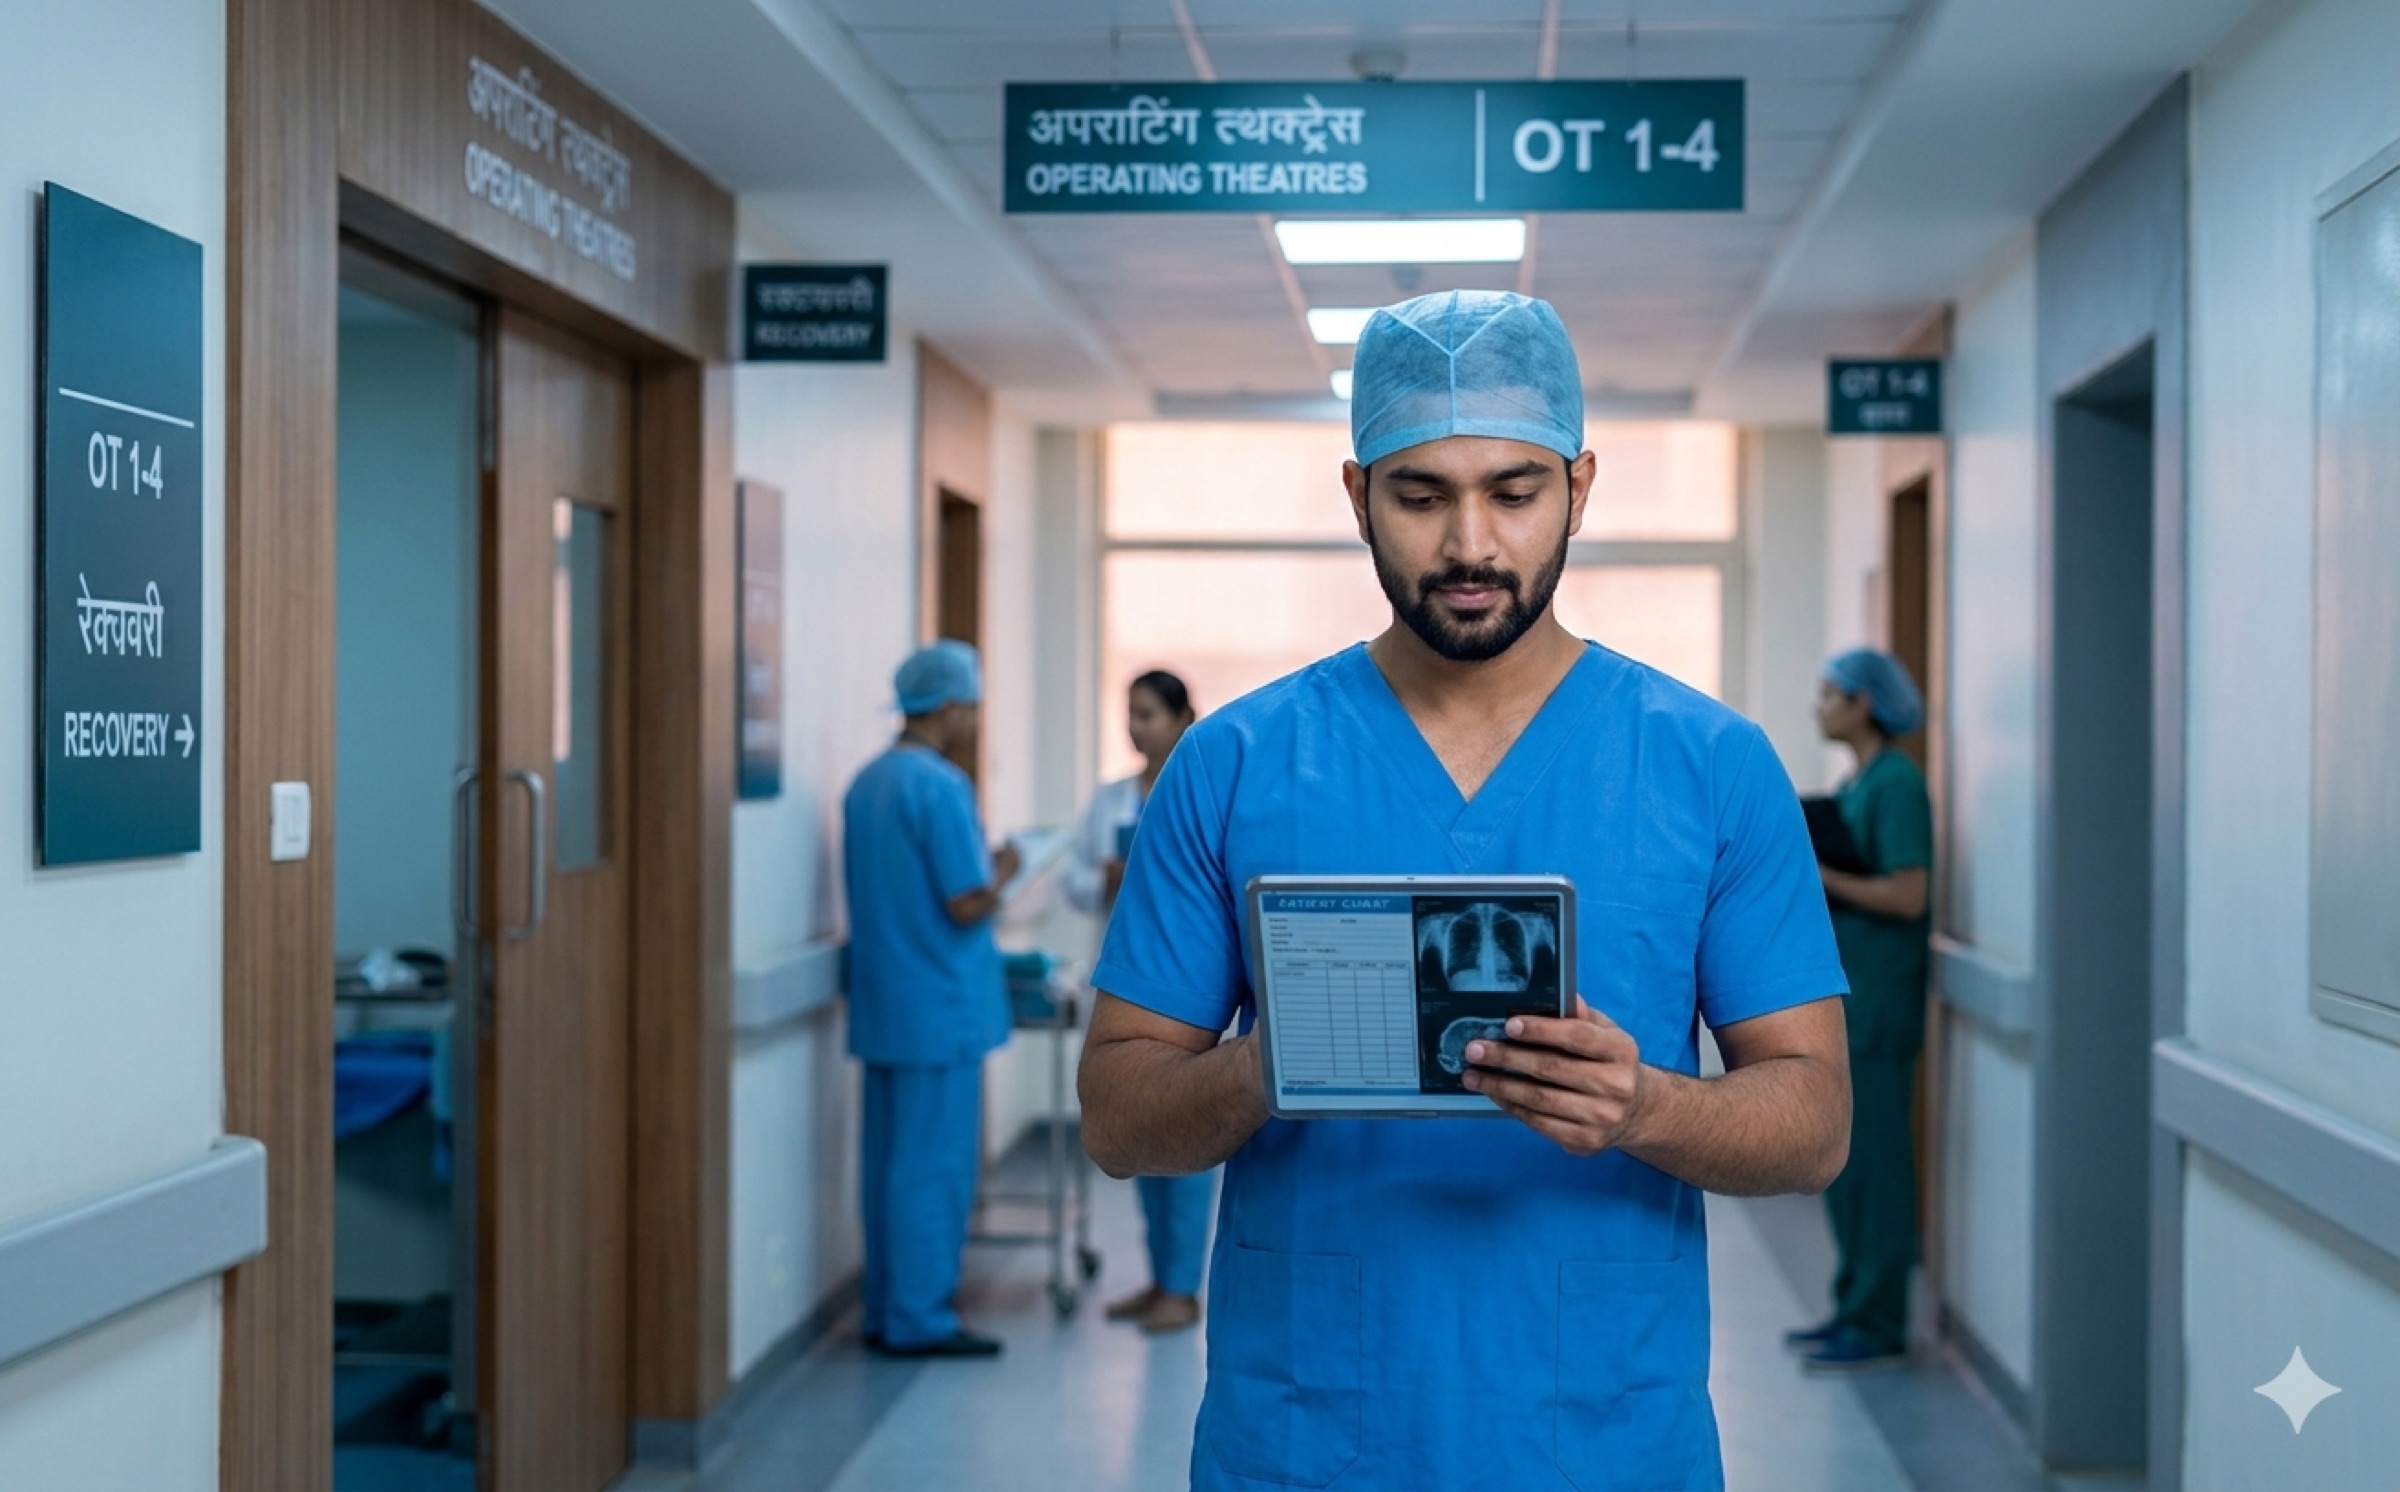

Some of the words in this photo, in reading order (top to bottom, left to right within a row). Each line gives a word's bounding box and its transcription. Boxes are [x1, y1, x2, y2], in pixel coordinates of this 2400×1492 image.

[1028, 94, 1201, 146] अपराटिंग
[1513, 118, 1605, 173] OT
[1625, 117, 1720, 173] 1-4
[1026, 162, 1201, 195] OPERATING
[1208, 161, 1368, 195] THEATRES
[464, 141, 560, 239] OPERATING
[561, 195, 637, 282] THEATRES
[88, 431, 122, 490] OT
[129, 440, 163, 499] 1-4
[64, 711, 170, 757] RECOVERY
